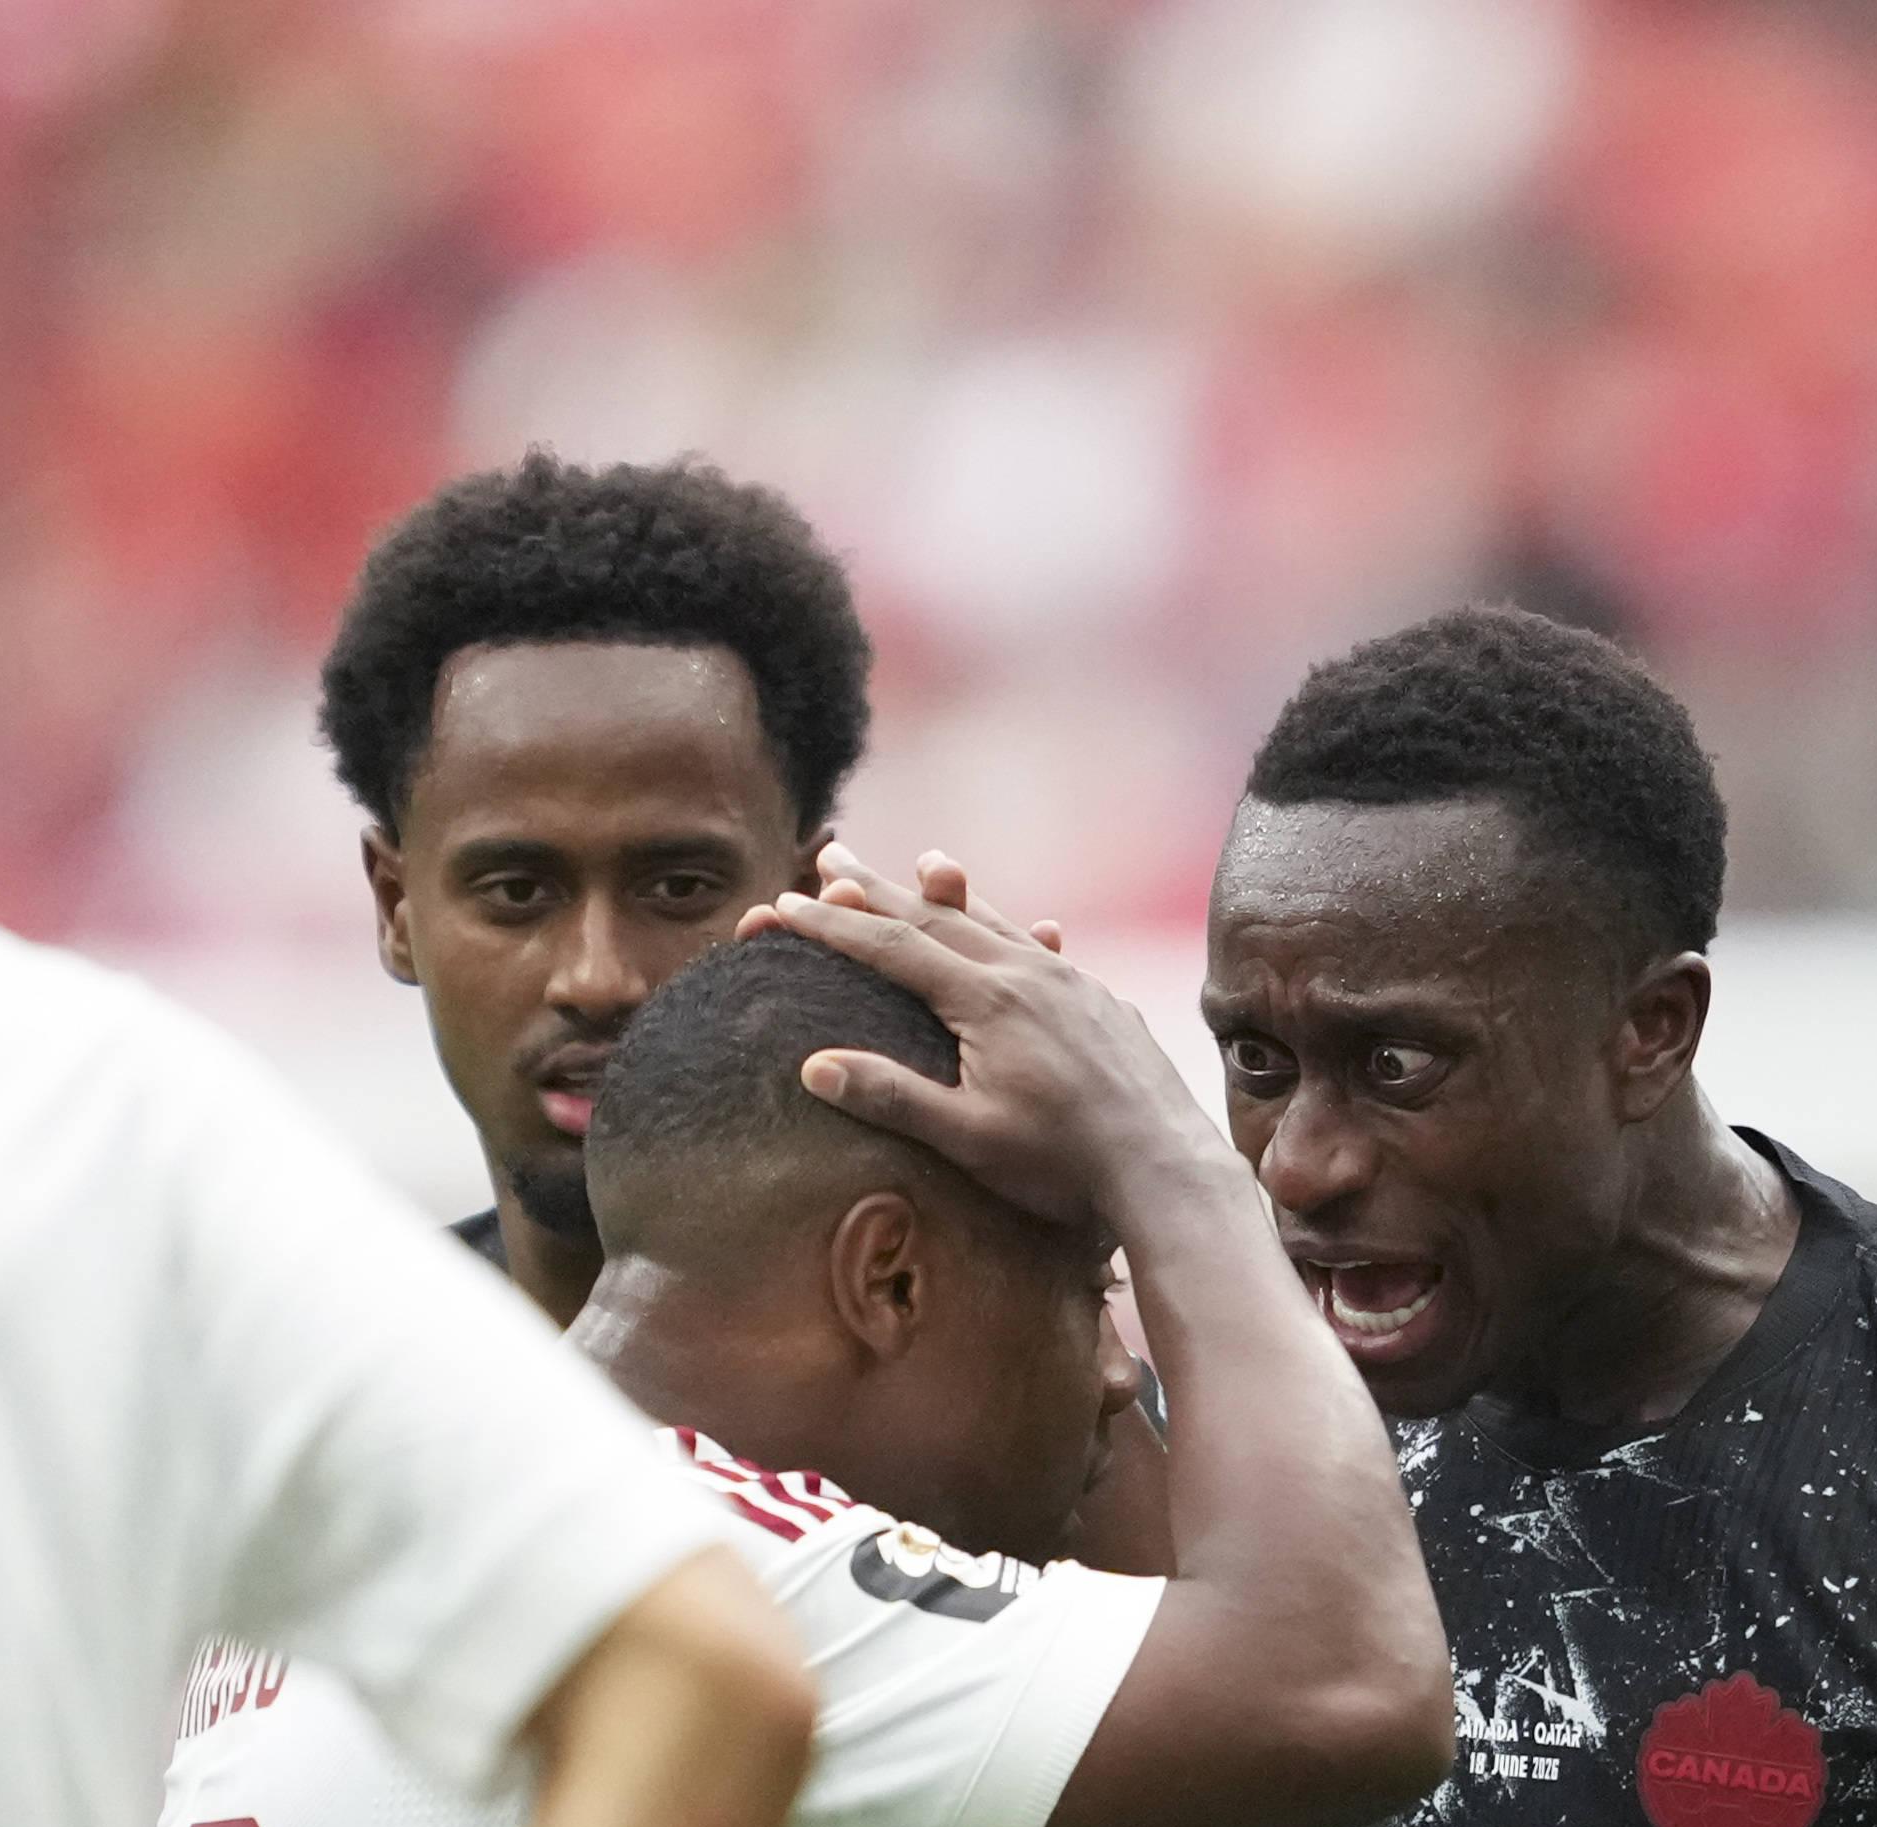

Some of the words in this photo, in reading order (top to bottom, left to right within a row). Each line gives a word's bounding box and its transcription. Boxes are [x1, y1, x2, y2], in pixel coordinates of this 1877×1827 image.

[1455, 1716, 1519, 1742] ANADA
[1534, 1722, 1583, 1748] QATAR
[1469, 1752, 1487, 1775] 18
[1491, 1753, 1528, 1778] JUNE
[1532, 1756, 1560, 1781] 2026
[1647, 1750, 1814, 1798] CANADA
